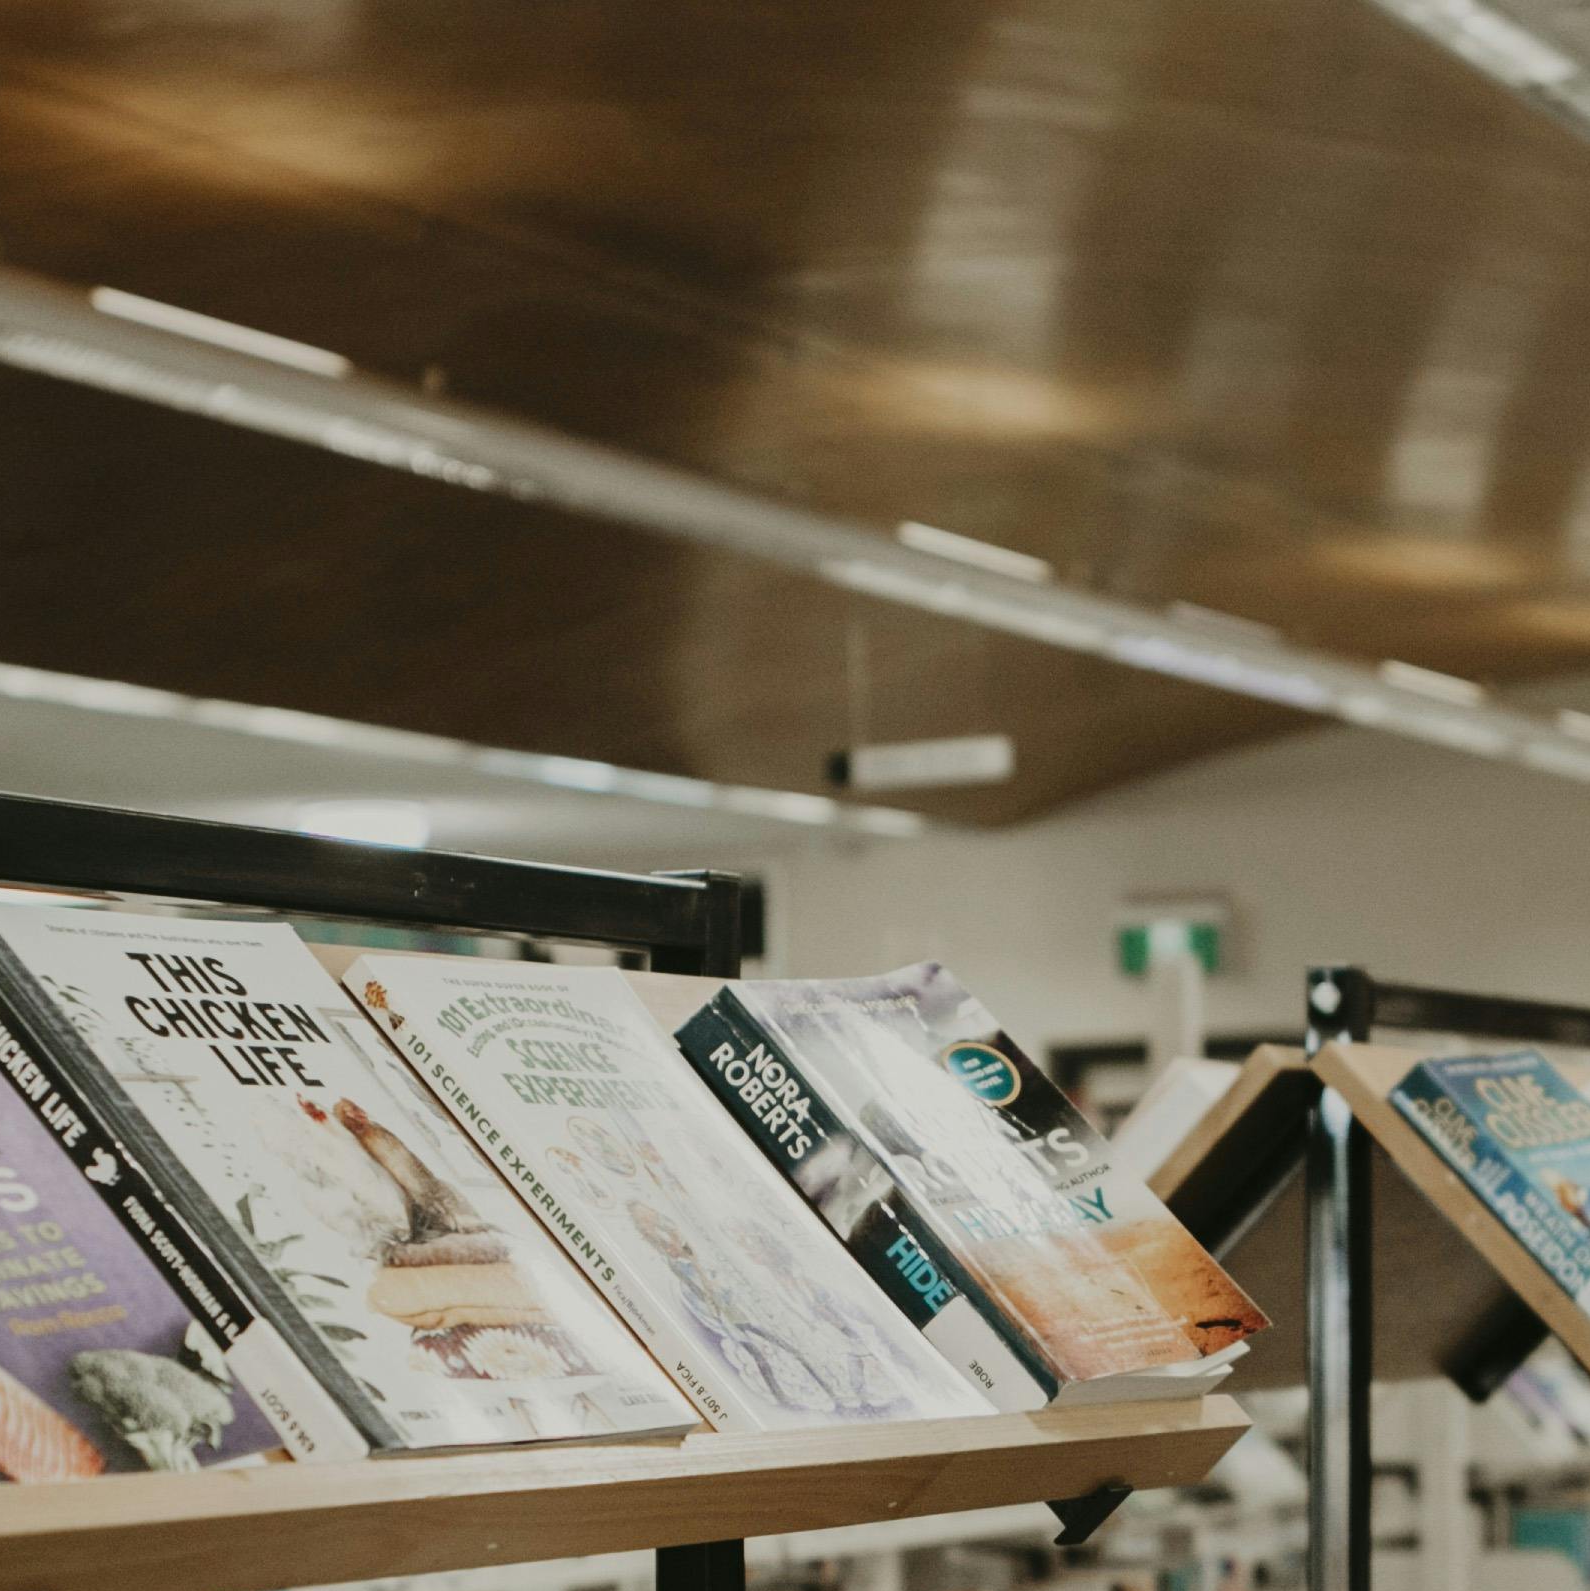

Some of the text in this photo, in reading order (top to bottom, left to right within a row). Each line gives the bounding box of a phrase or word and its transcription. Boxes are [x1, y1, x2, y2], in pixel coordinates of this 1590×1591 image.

[125, 952, 247, 996] THIS
[125, 995, 331, 1044] CHICKEN
[436, 992, 626, 1038] 101 Extraordina
[209, 1044, 326, 1087] LIFE
[505, 1037, 621, 1074] SCIENCE
[501, 1072, 681, 1111] EXPERIMENTS
[709, 1041, 813, 1160] ROBERTS
[746, 1043, 811, 1124] NORA
[38, 1084, 87, 1148] LIFE
[407, 1034, 616, 1282] 101 SCIENCE EXPERIMENTS
[17, 1222, 63, 1244] TO
[676, 1360, 701, 1388] FICA
[968, 1360, 995, 1390] ROBE
[718, 1409, 729, 1422] J
